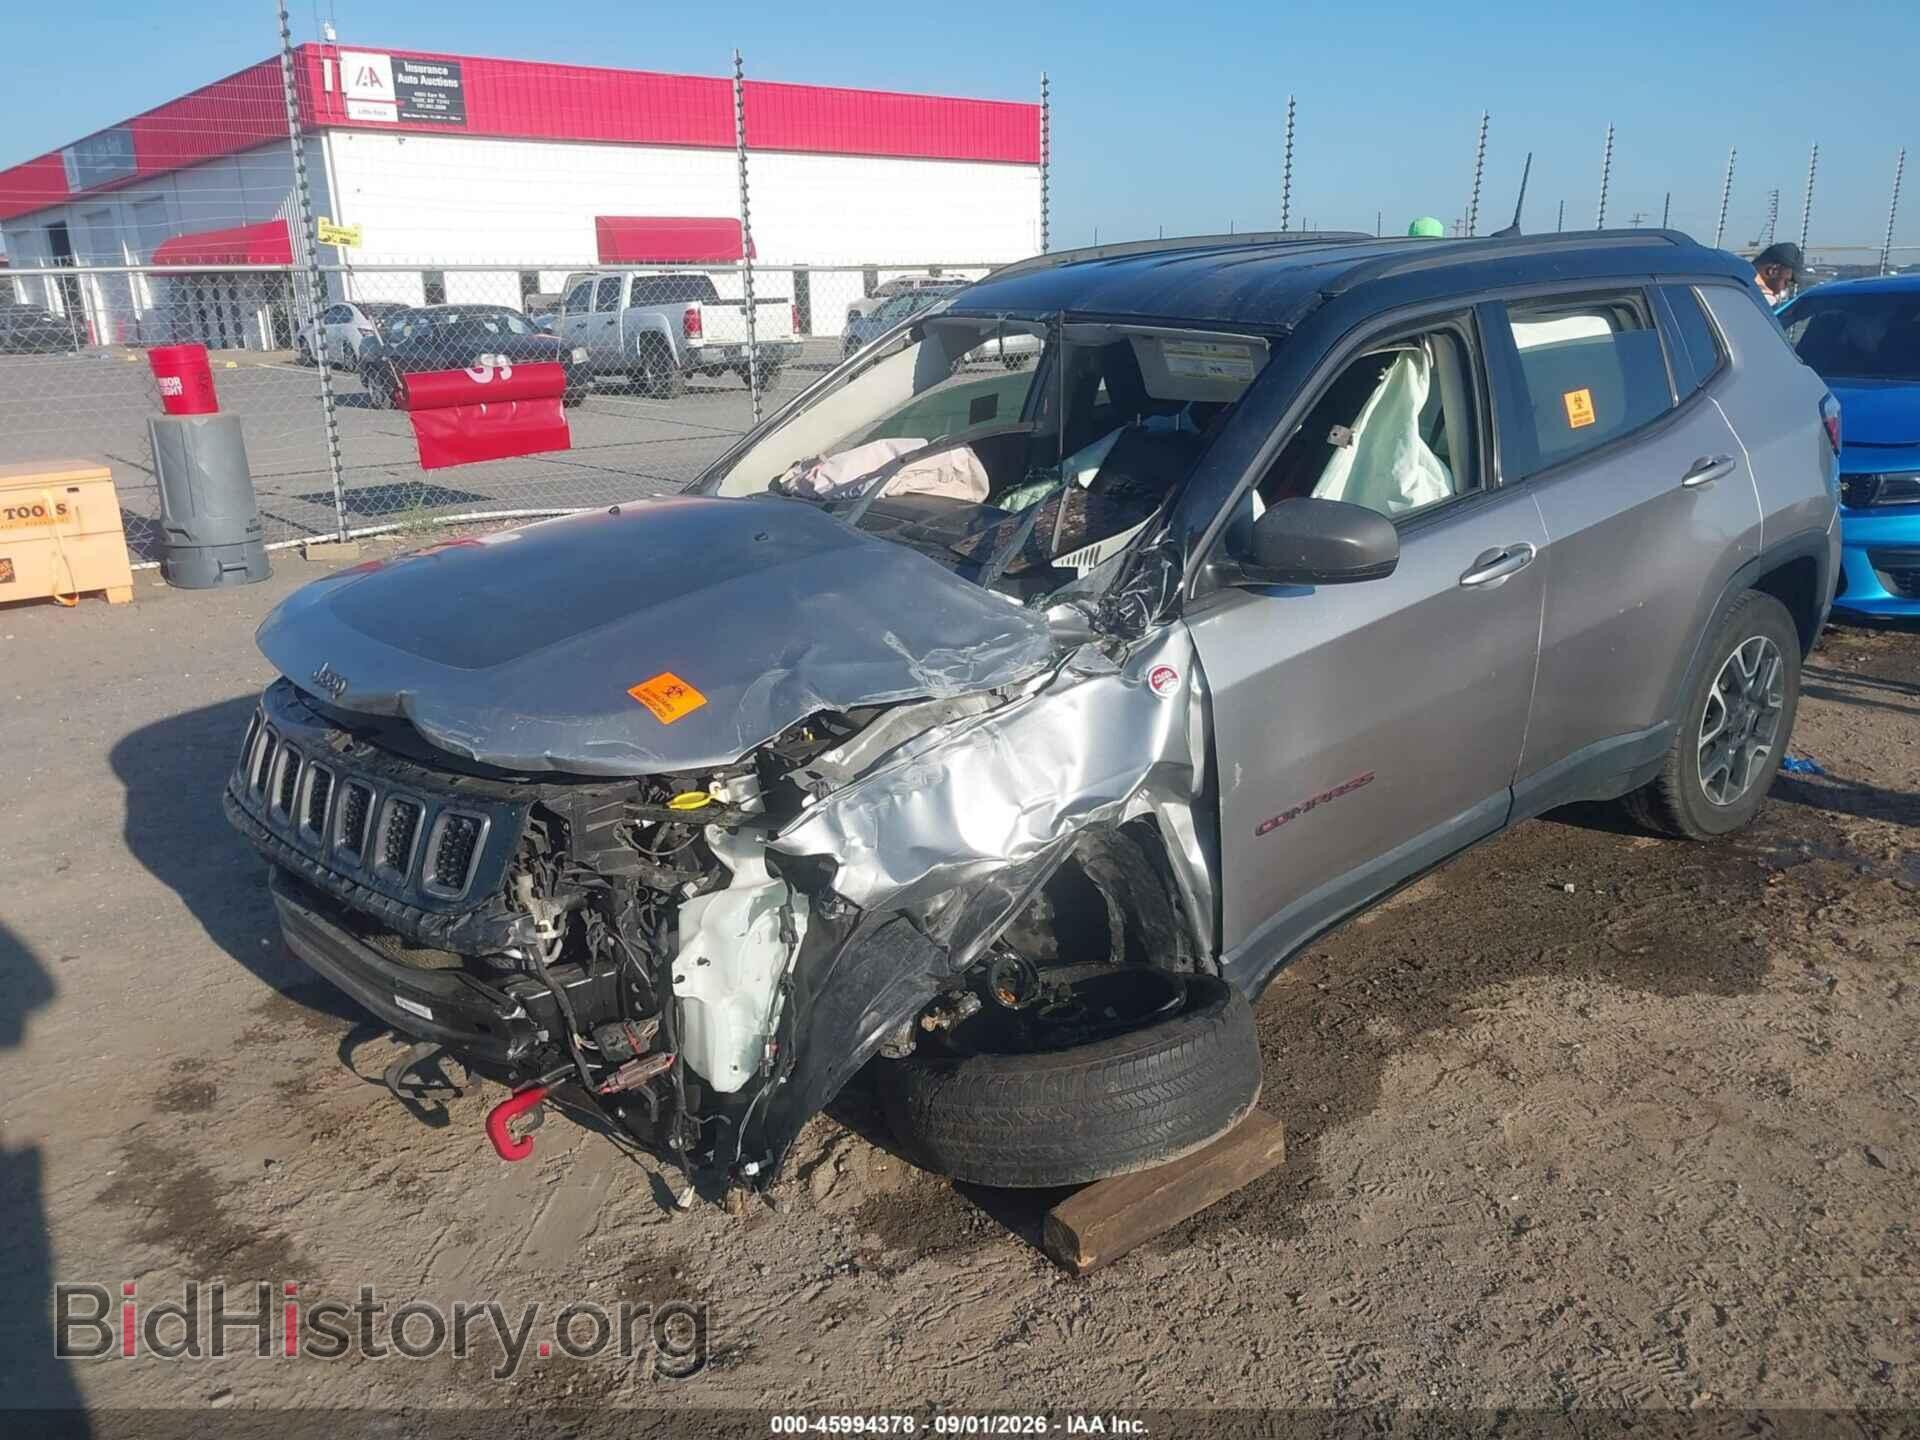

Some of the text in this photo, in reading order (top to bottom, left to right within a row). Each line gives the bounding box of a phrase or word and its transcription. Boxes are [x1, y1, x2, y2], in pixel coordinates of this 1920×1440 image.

[404, 62, 449, 76] Insurance
[397, 73, 459, 88] Auto Auctions
[3, 503, 67, 520] TOOS
